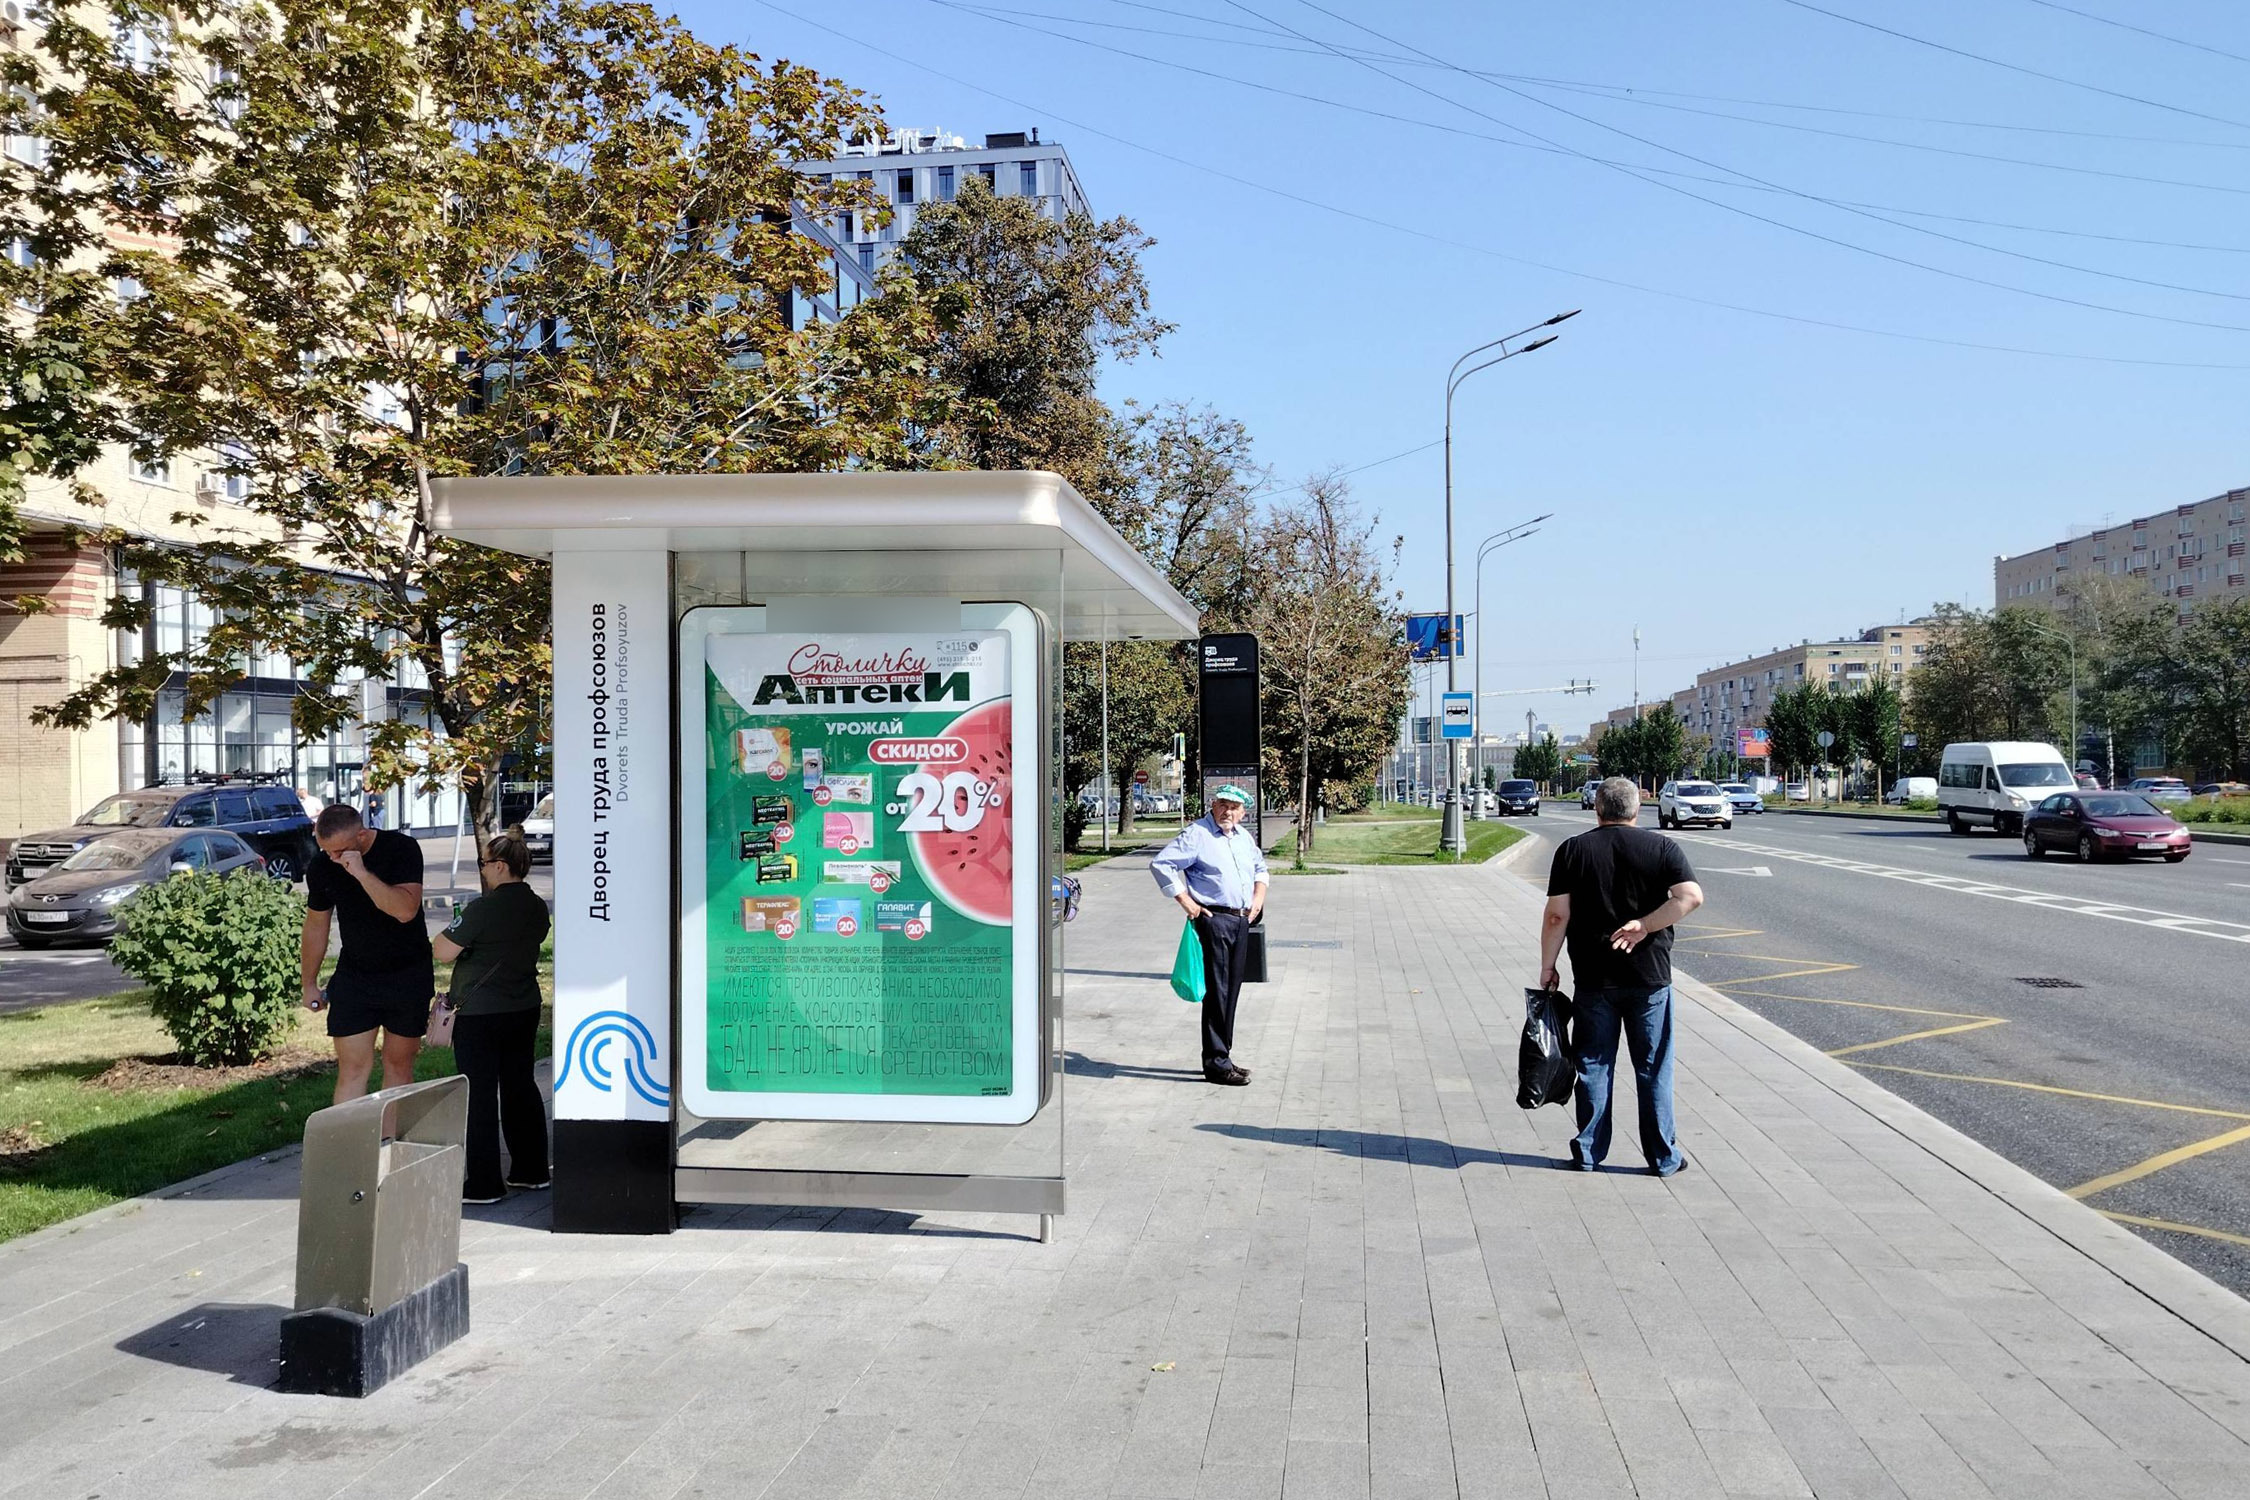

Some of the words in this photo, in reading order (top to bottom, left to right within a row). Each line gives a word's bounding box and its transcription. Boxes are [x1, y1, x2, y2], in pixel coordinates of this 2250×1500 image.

[615, 603, 631, 693] Profsoyuzov
[787, 643, 932, 676] Столички
[587, 603, 611, 749] профсоюзов
[796, 677, 818, 686] сеть
[821, 676, 888, 686] социальных
[890, 675, 923, 684] аптек
[616, 698, 629, 740] Truda
[825, 717, 904, 736] УРОЖАЙ
[877, 743, 959, 761] СКИДОК
[594, 757, 611, 823] труда
[616, 745, 629, 802] Dvorets
[885, 802, 908, 815] от
[896, 771, 1002, 832] 20%
[590, 831, 611, 921] Дворец
[723, 976, 782, 998] ИМЕЮТСЯ
[786, 976, 916, 999] ПРОТИВОПОКАЗАНИЯ.
[918, 977, 1002, 1001] НЕОБХОДИМО
[723, 1001, 797, 1023] ПОЛУЧЕНИЕ
[805, 1001, 903, 1024] КОНСУЛЬТАЦИИ
[911, 1002, 1003, 1025] СПЕЦИАЛИСТА
[767, 1025, 787, 1075] НЕ
[791, 1025, 877, 1076] ЯВЛЯЕТСЯ
[881, 1025, 1003, 1050] ЛЕКАРСТВЕННЫМ
[881, 1050, 1003, 1079] СРЕДСТВОМ
